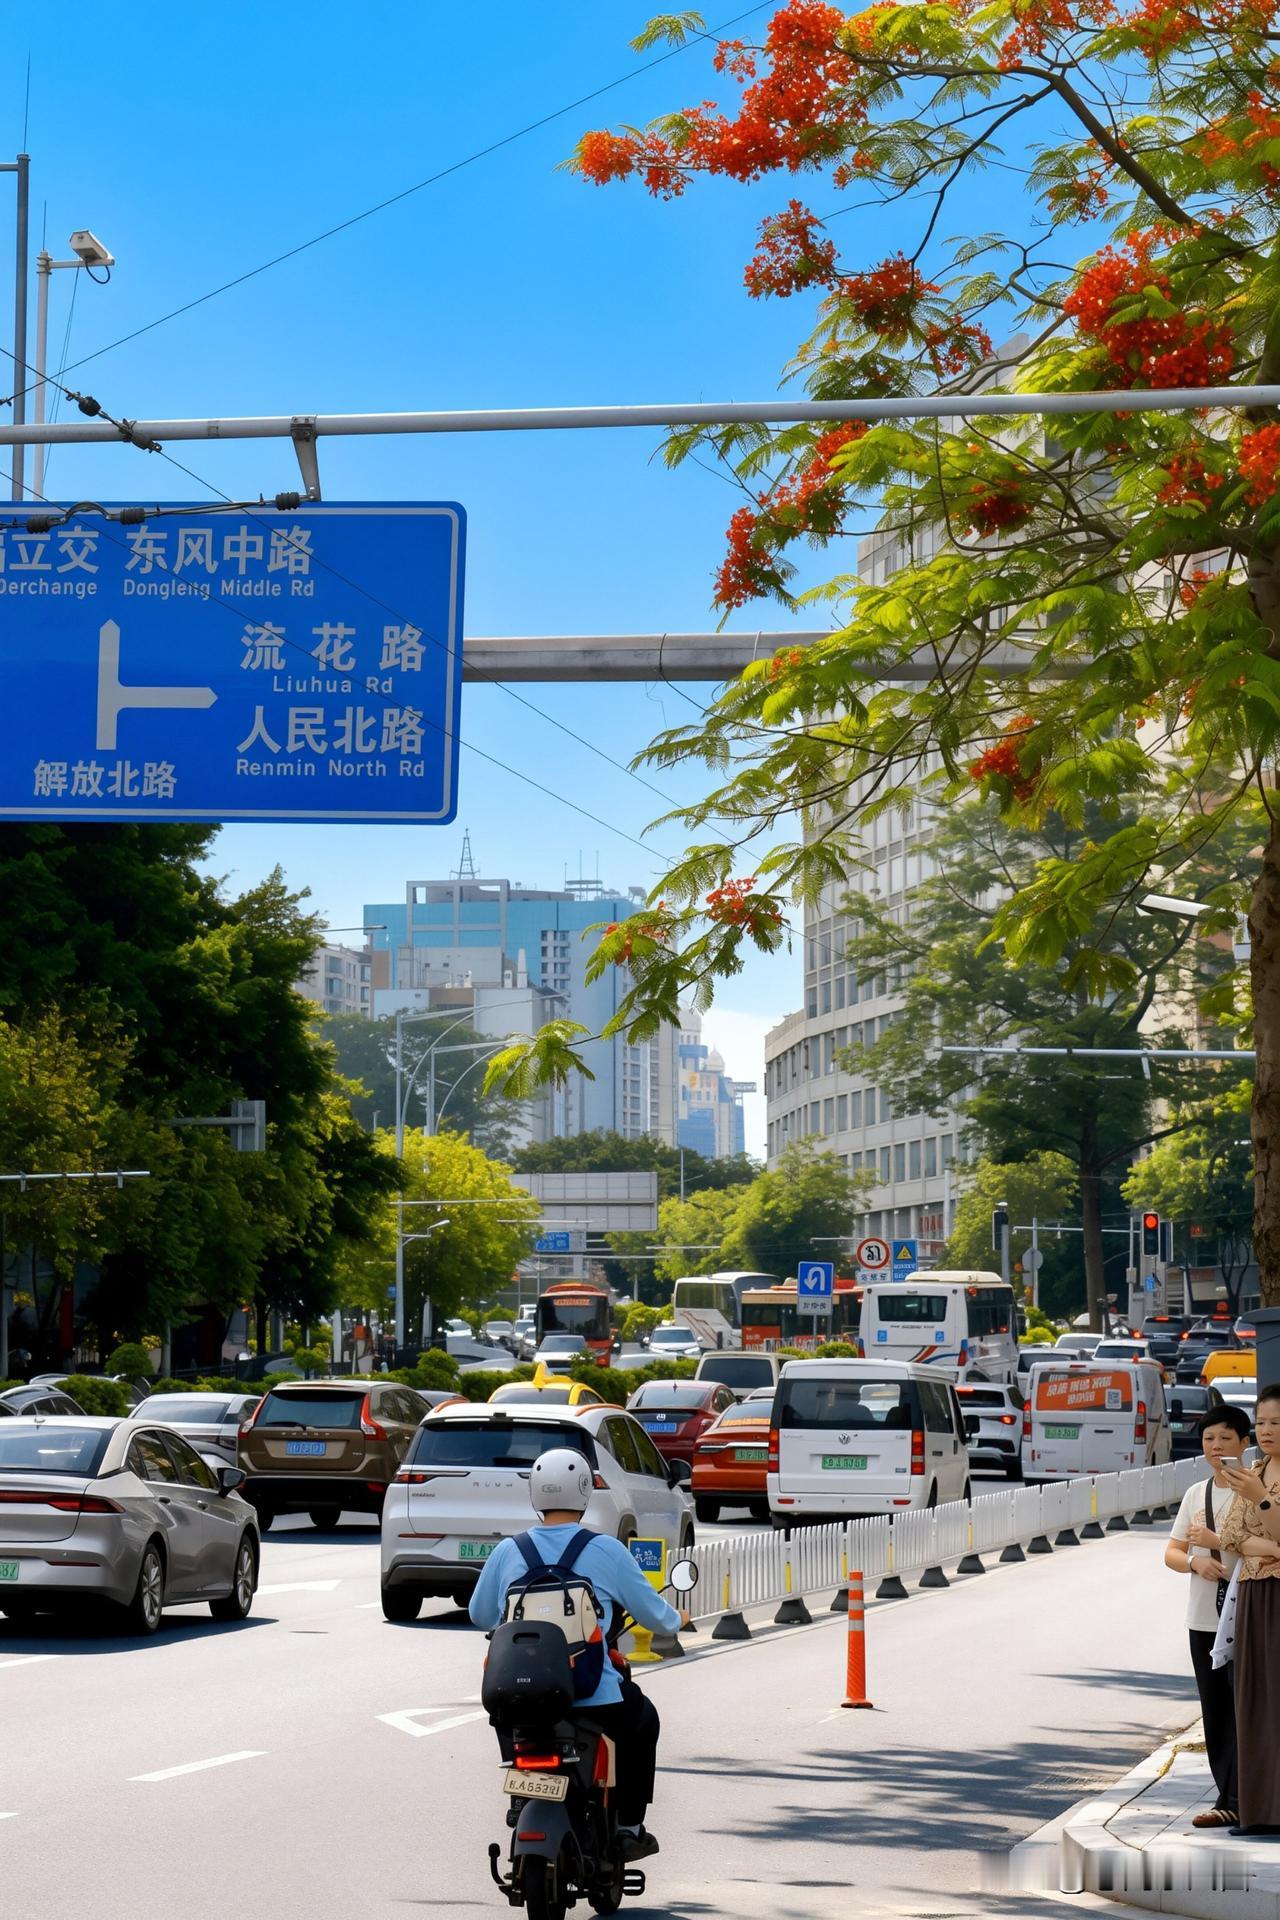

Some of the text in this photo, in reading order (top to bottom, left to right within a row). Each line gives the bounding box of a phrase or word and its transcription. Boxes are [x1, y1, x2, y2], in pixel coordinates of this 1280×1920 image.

[125, 525, 314, 575] 东风中路
[221, 579, 281, 597] Middle
[291, 579, 314, 597] Rd
[272, 675, 393, 694] Liuhua Rd
[236, 705, 426, 755] 人民北路
[33, 759, 178, 798] 解放北路
[236, 758, 425, 777] Renmin North Rd
